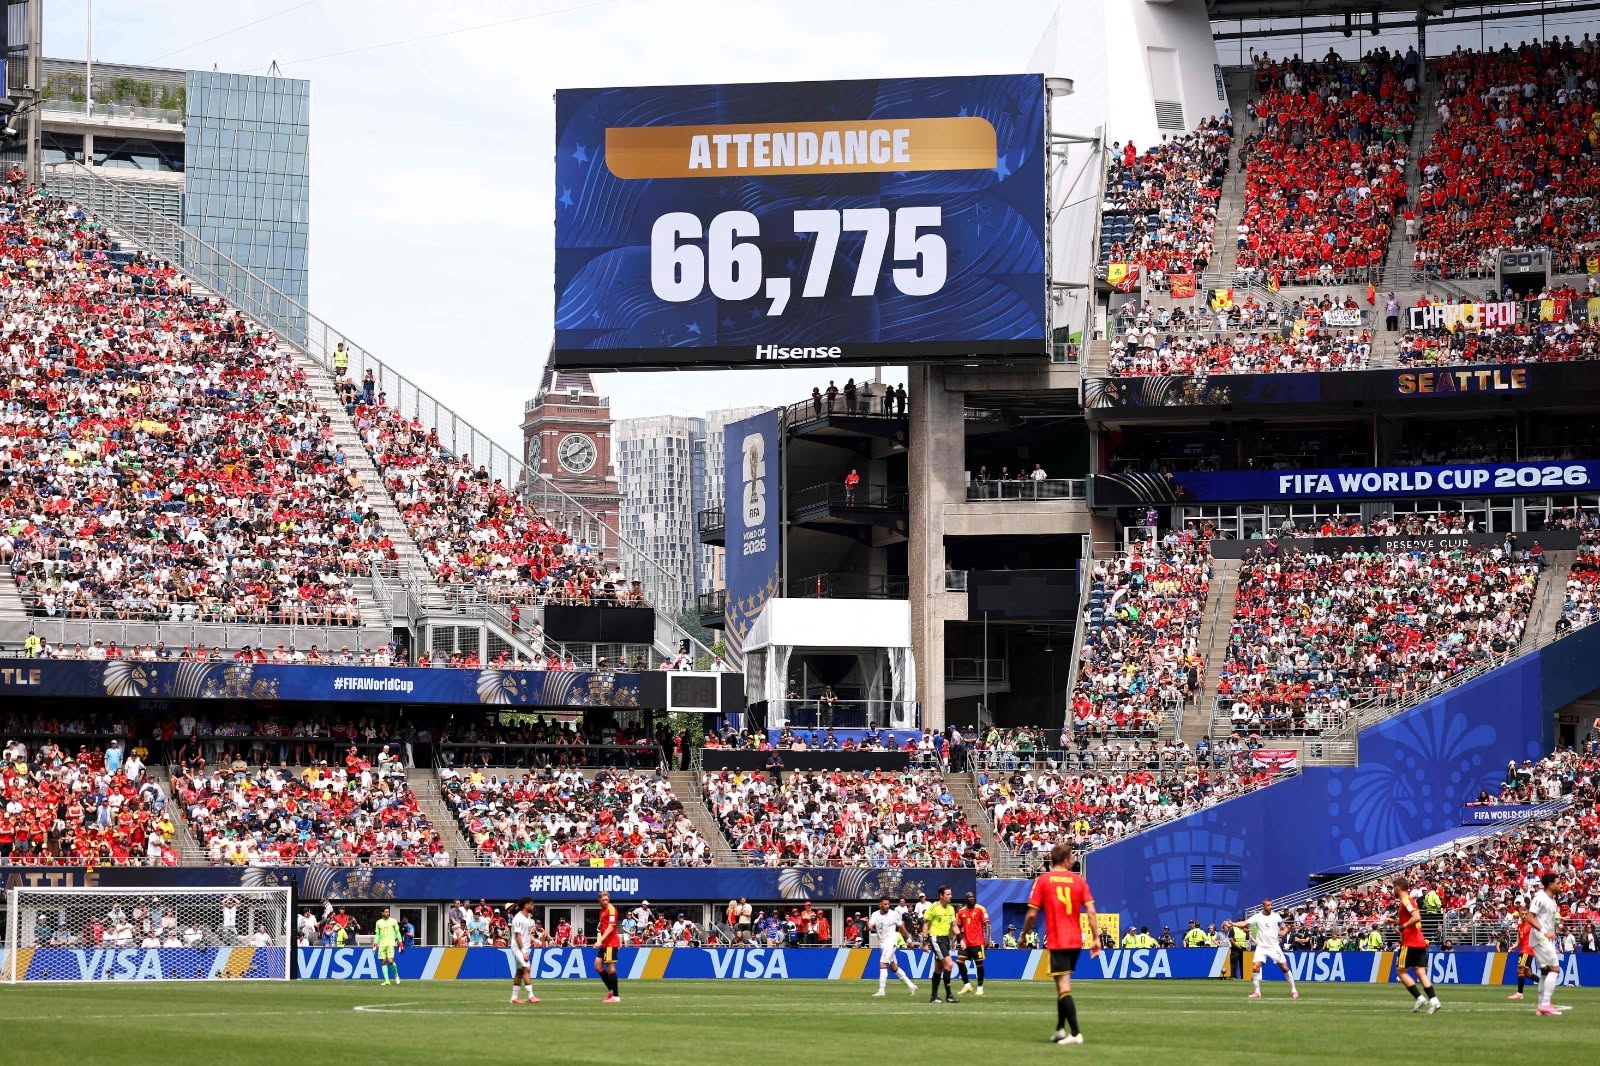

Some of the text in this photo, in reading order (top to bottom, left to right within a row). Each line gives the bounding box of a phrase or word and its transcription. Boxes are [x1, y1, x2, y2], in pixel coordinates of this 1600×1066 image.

[689, 128, 911, 170] ATTENDANCE
[650, 206, 948, 317] 66,775
[1504, 254, 1543, 267] 301
[755, 344, 842, 360] Hisense
[1398, 368, 1527, 394] SEATTLE
[1279, 465, 1588, 494] FIFA WORLD CUP 2026
[749, 506, 760, 519] FIFA
[743, 539, 767, 556] 2026
[1439, 539, 1469, 548] CLUB
[333, 677, 414, 694] #FIFAWorldCup
[1474, 812, 1490, 820] FIFA
[1490, 811, 1516, 819] WORLD
[529, 875, 639, 895] #FIFAWorldCup
[1056, 886, 1073, 915] 4
[67, 948, 163, 980] VISA
[297, 948, 379, 979] VISA
[498, 948, 587, 979] VISA
[702, 948, 789, 979] VISA
[1099, 949, 1172, 979] VISA
[1284, 952, 1346, 982] VISA
[1417, 953, 1459, 984] ISA
